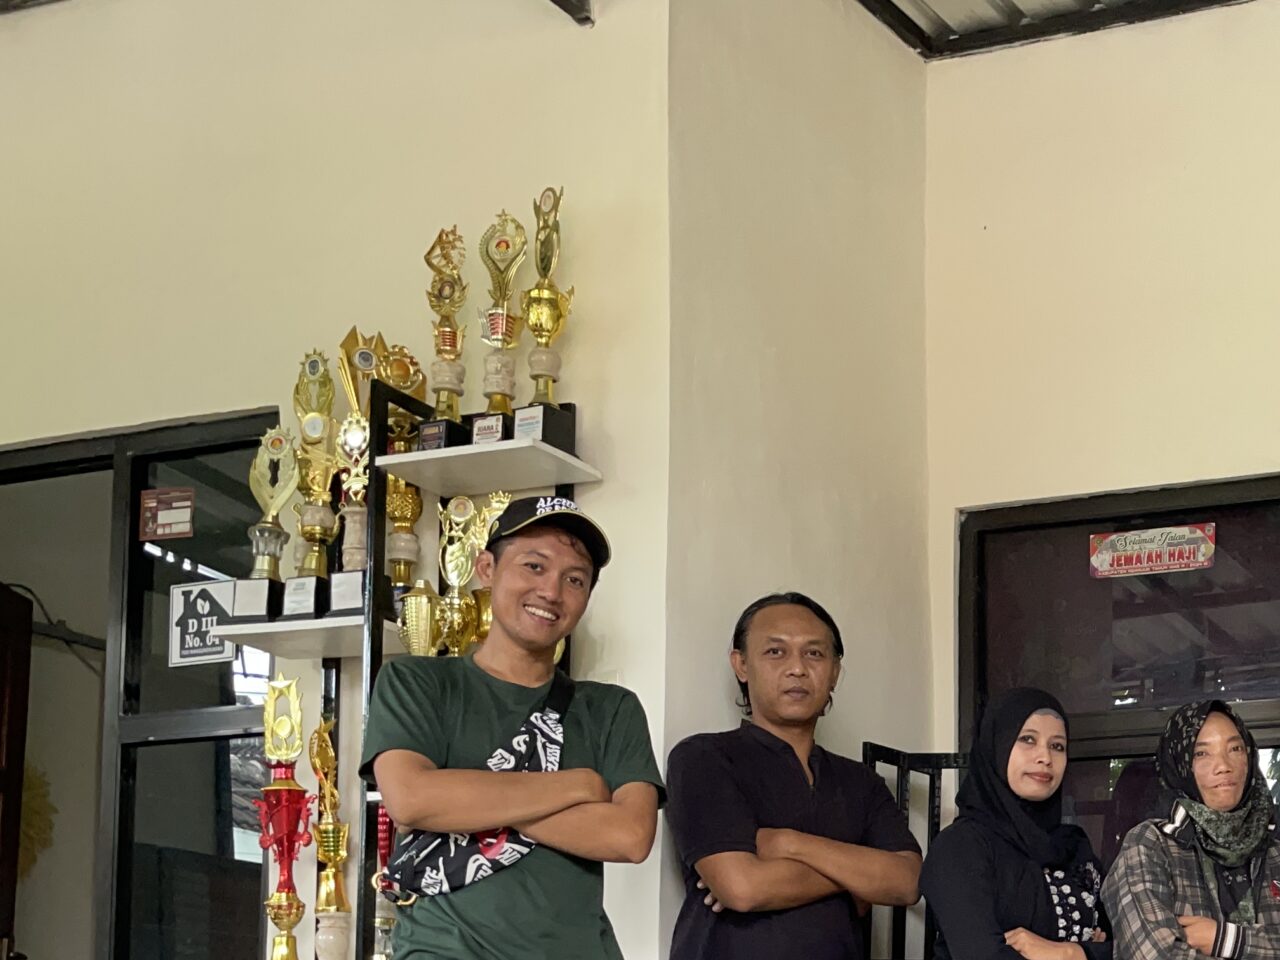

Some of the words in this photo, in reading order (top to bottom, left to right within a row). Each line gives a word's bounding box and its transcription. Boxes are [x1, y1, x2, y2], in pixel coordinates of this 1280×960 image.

[1117, 536, 1156, 549] Selamat
[1157, 531, 1186, 545] Jalan
[1167, 545, 1197, 562] HAJI
[188, 619, 198, 633] D
[201, 616, 218, 631] III
[185, 634, 203, 648] No.
